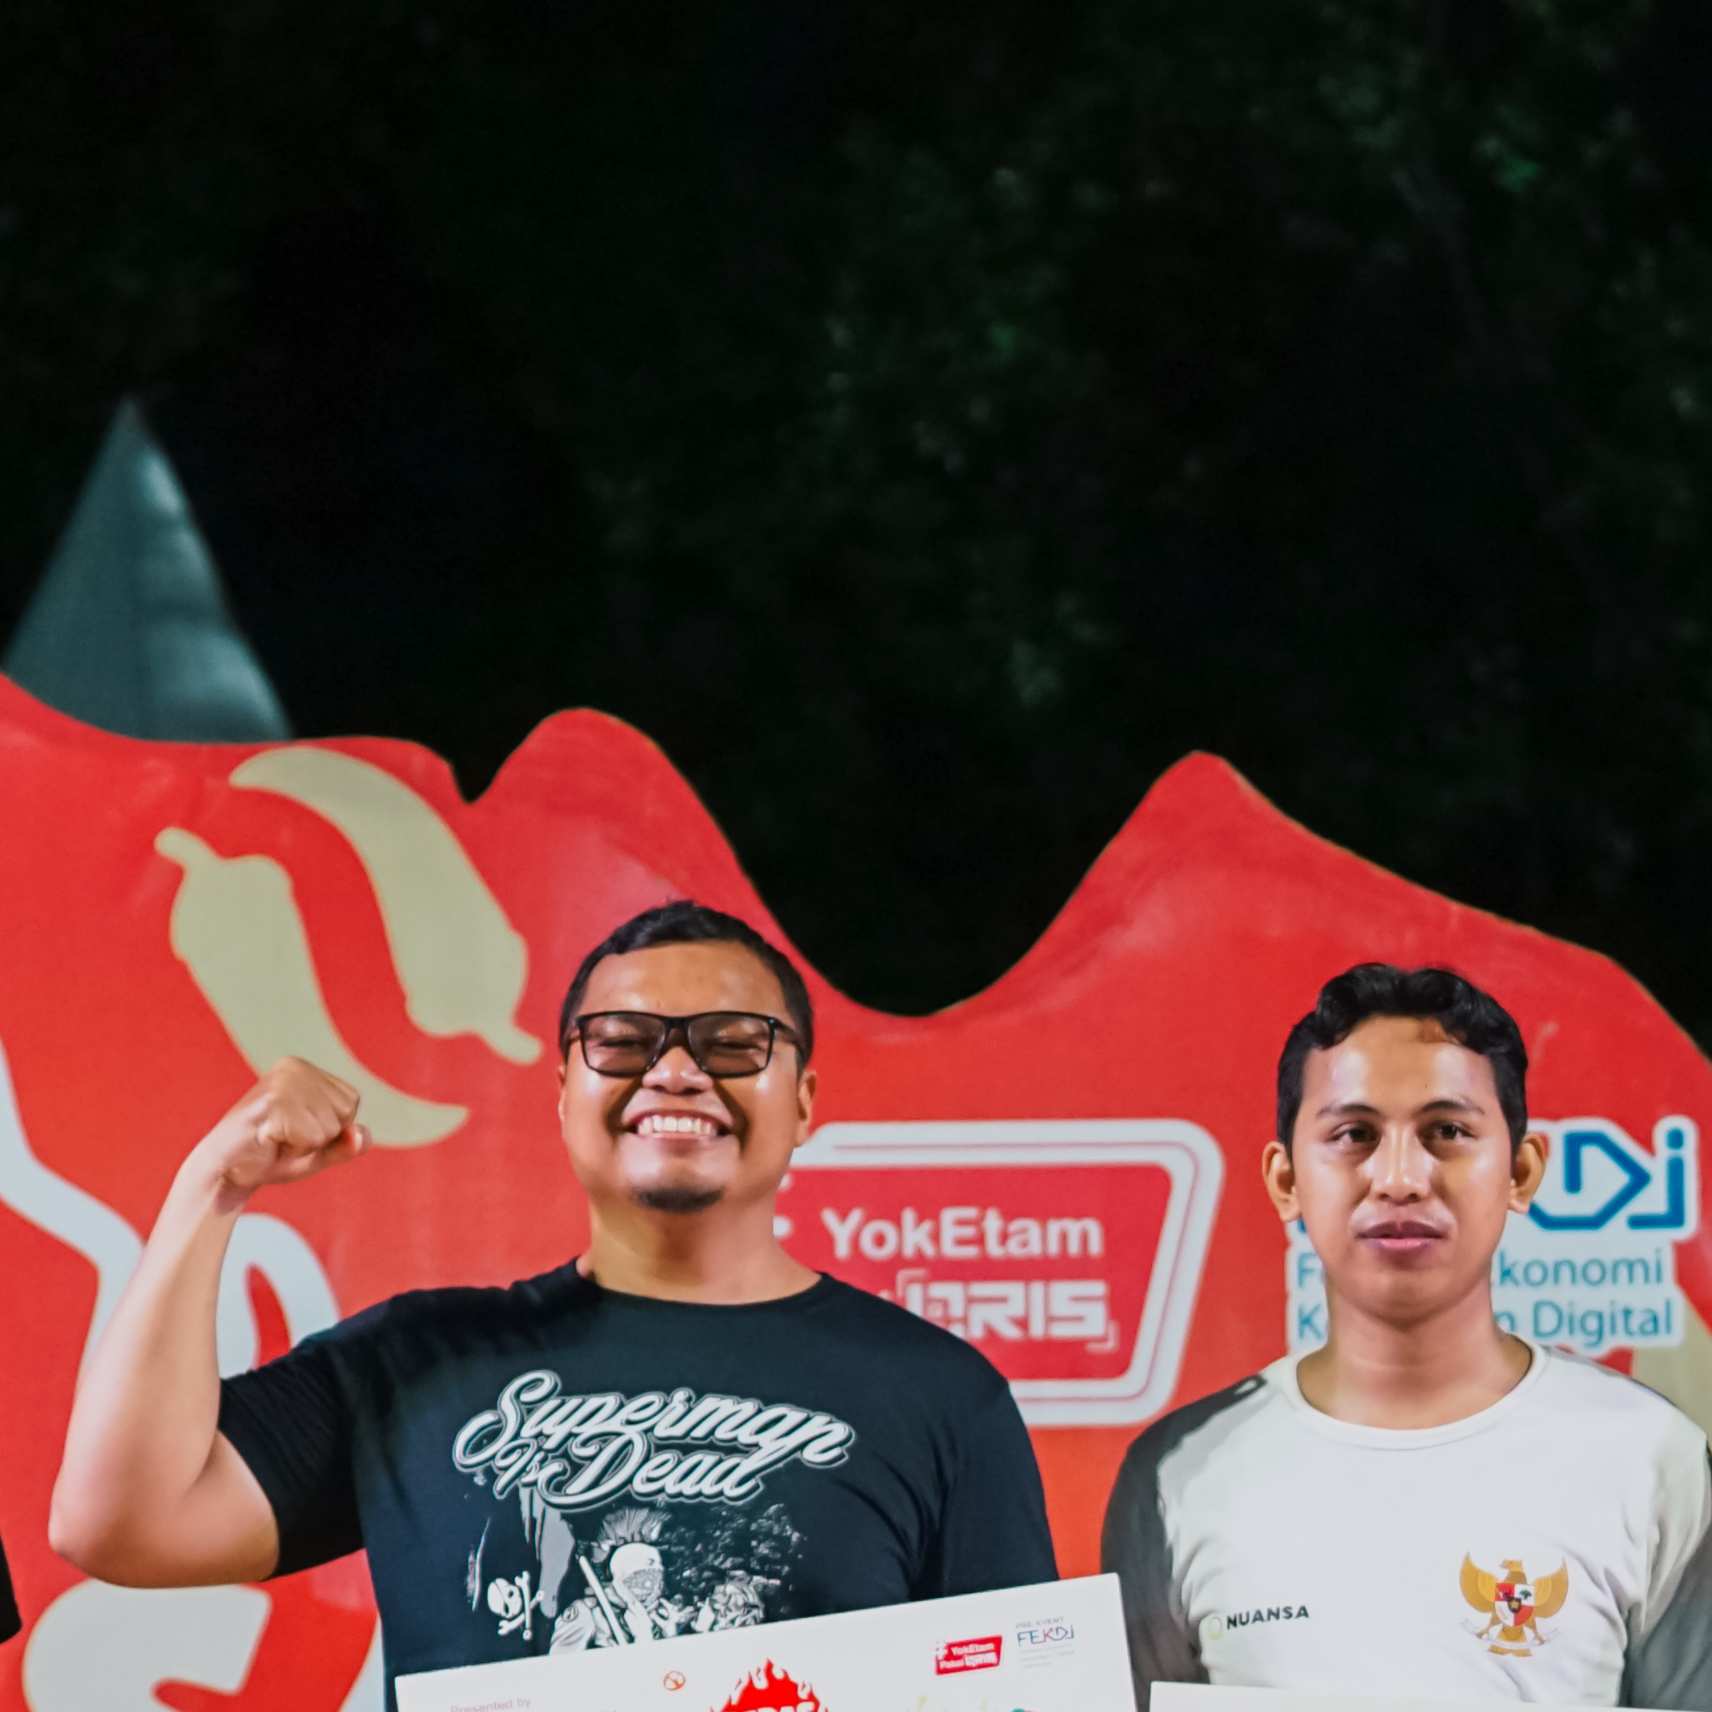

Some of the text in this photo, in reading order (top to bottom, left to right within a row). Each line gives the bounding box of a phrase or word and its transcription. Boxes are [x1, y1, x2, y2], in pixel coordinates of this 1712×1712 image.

[821, 1206, 1103, 1259] YokEtam
[1492, 1249, 1664, 1289] konomi
[1532, 1299, 1673, 1349] Digital
[453, 1369, 855, 1471] Superman
[534, 1426, 767, 1510] Dead
[1226, 1605, 1309, 1630] NUANSA
[516, 1697, 531, 1711] by
